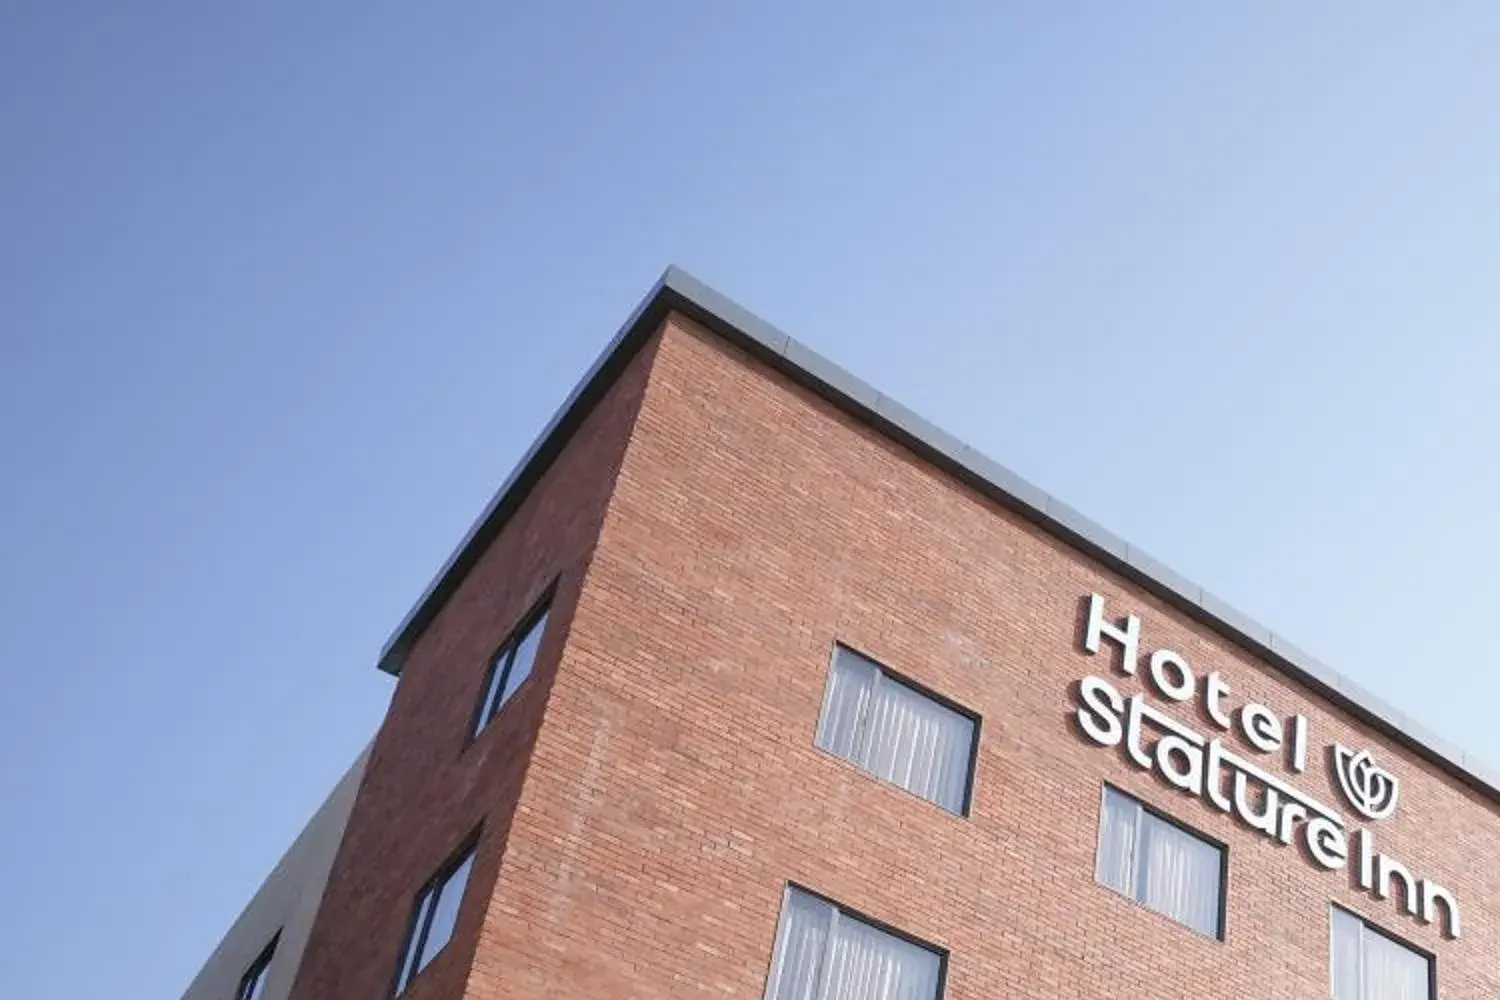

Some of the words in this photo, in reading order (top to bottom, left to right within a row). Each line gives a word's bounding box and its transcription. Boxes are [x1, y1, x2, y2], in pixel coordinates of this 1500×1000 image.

[1084, 592, 1309, 773] Hotel
[1078, 675, 1347, 869] Stature
[1357, 827, 1460, 939] Inn
